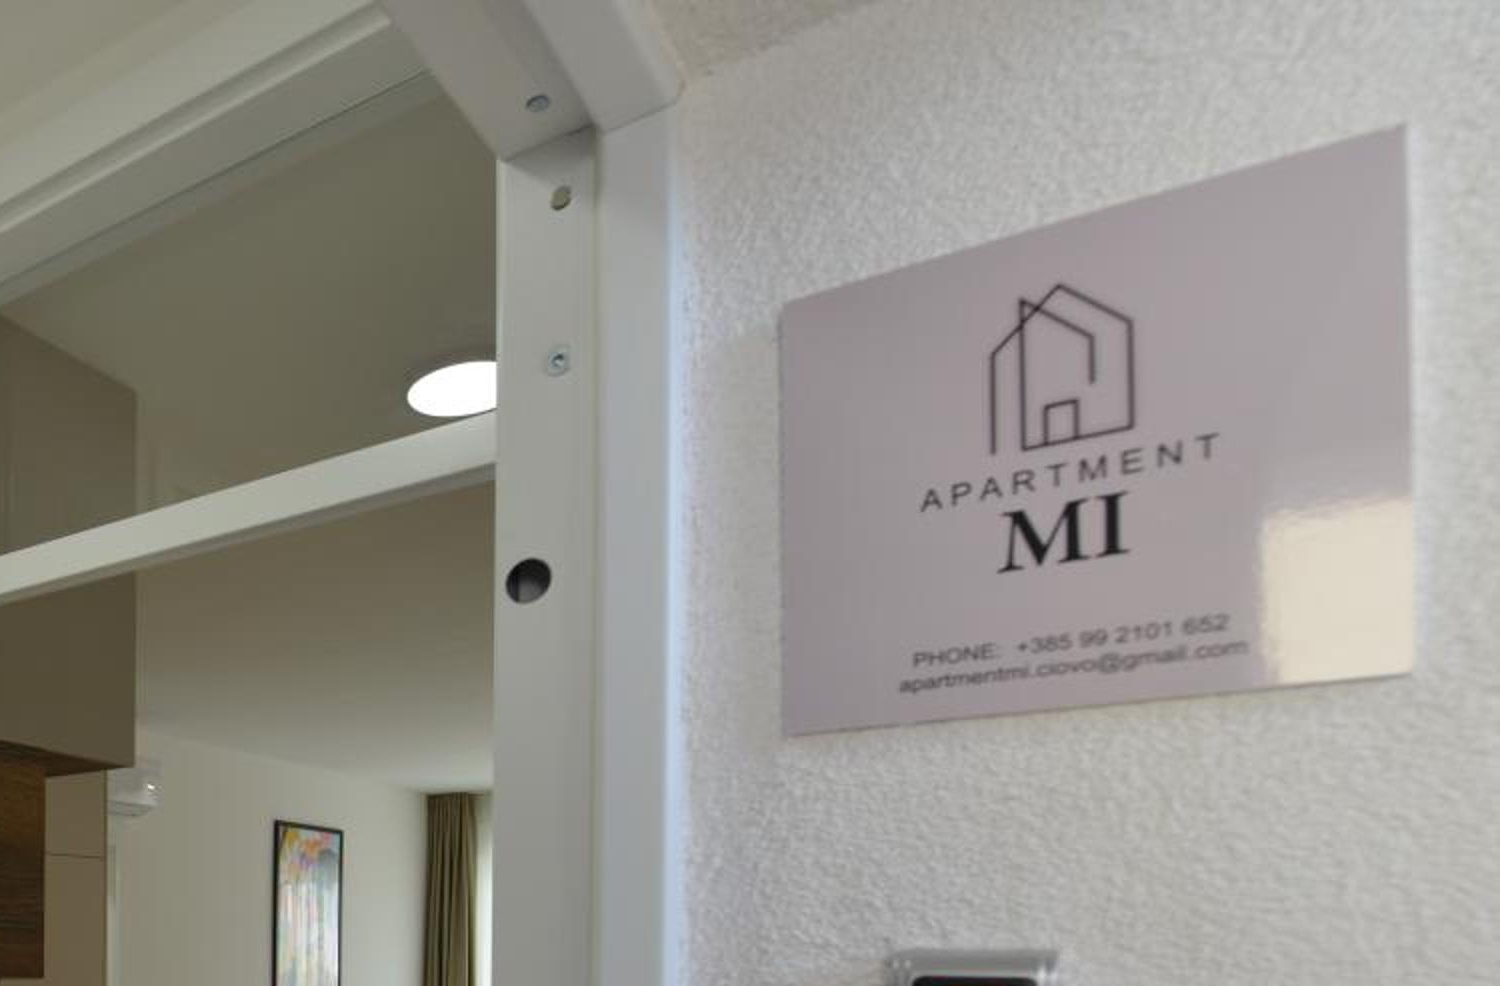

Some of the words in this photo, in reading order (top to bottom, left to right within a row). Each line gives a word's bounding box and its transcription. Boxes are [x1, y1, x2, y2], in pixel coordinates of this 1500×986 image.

[919, 432, 1220, 513] APARTMENT
[996, 490, 1132, 575] MI
[1018, 632, 1073, 654] +385
[1079, 627, 1108, 648] 99
[1114, 620, 1173, 644] 2101
[1180, 612, 1231, 636] 652
